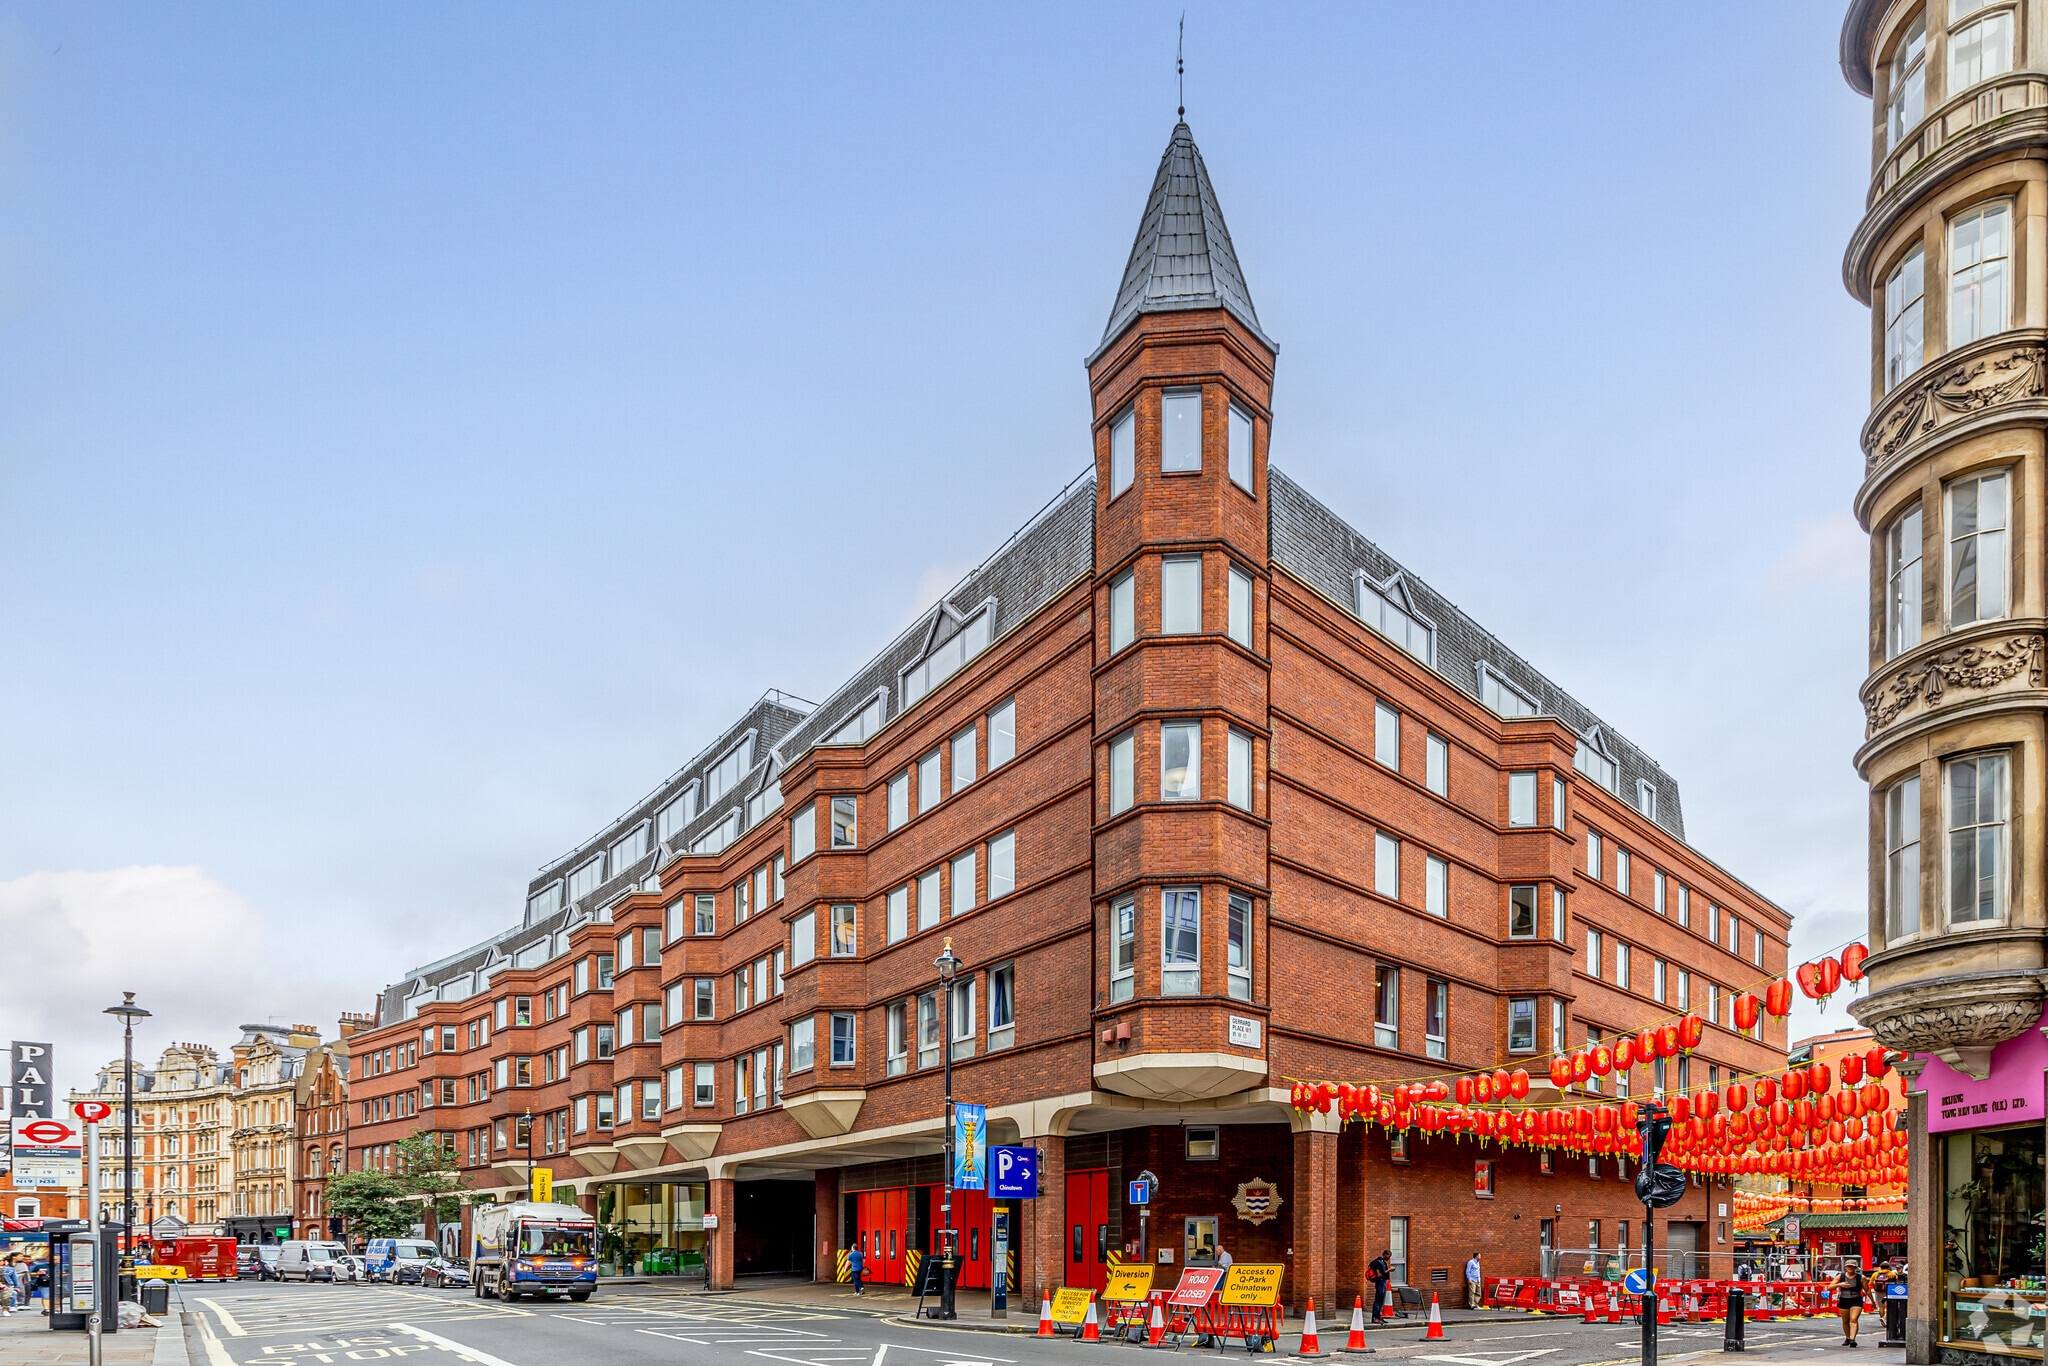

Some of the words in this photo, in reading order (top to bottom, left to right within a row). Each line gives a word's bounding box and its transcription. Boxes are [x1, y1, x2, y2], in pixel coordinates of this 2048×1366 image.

[1941, 1108, 1956, 1119] TONG
[1971, 1104, 1987, 1114] TANG
[1115, 1270, 1149, 1278] Diversion
[1188, 1276, 1209, 1284] ROAD
[1178, 1290, 1206, 1298] CLOSED
[261, 1336, 392, 1354] BUS
[244, 1344, 429, 1366] STOP
